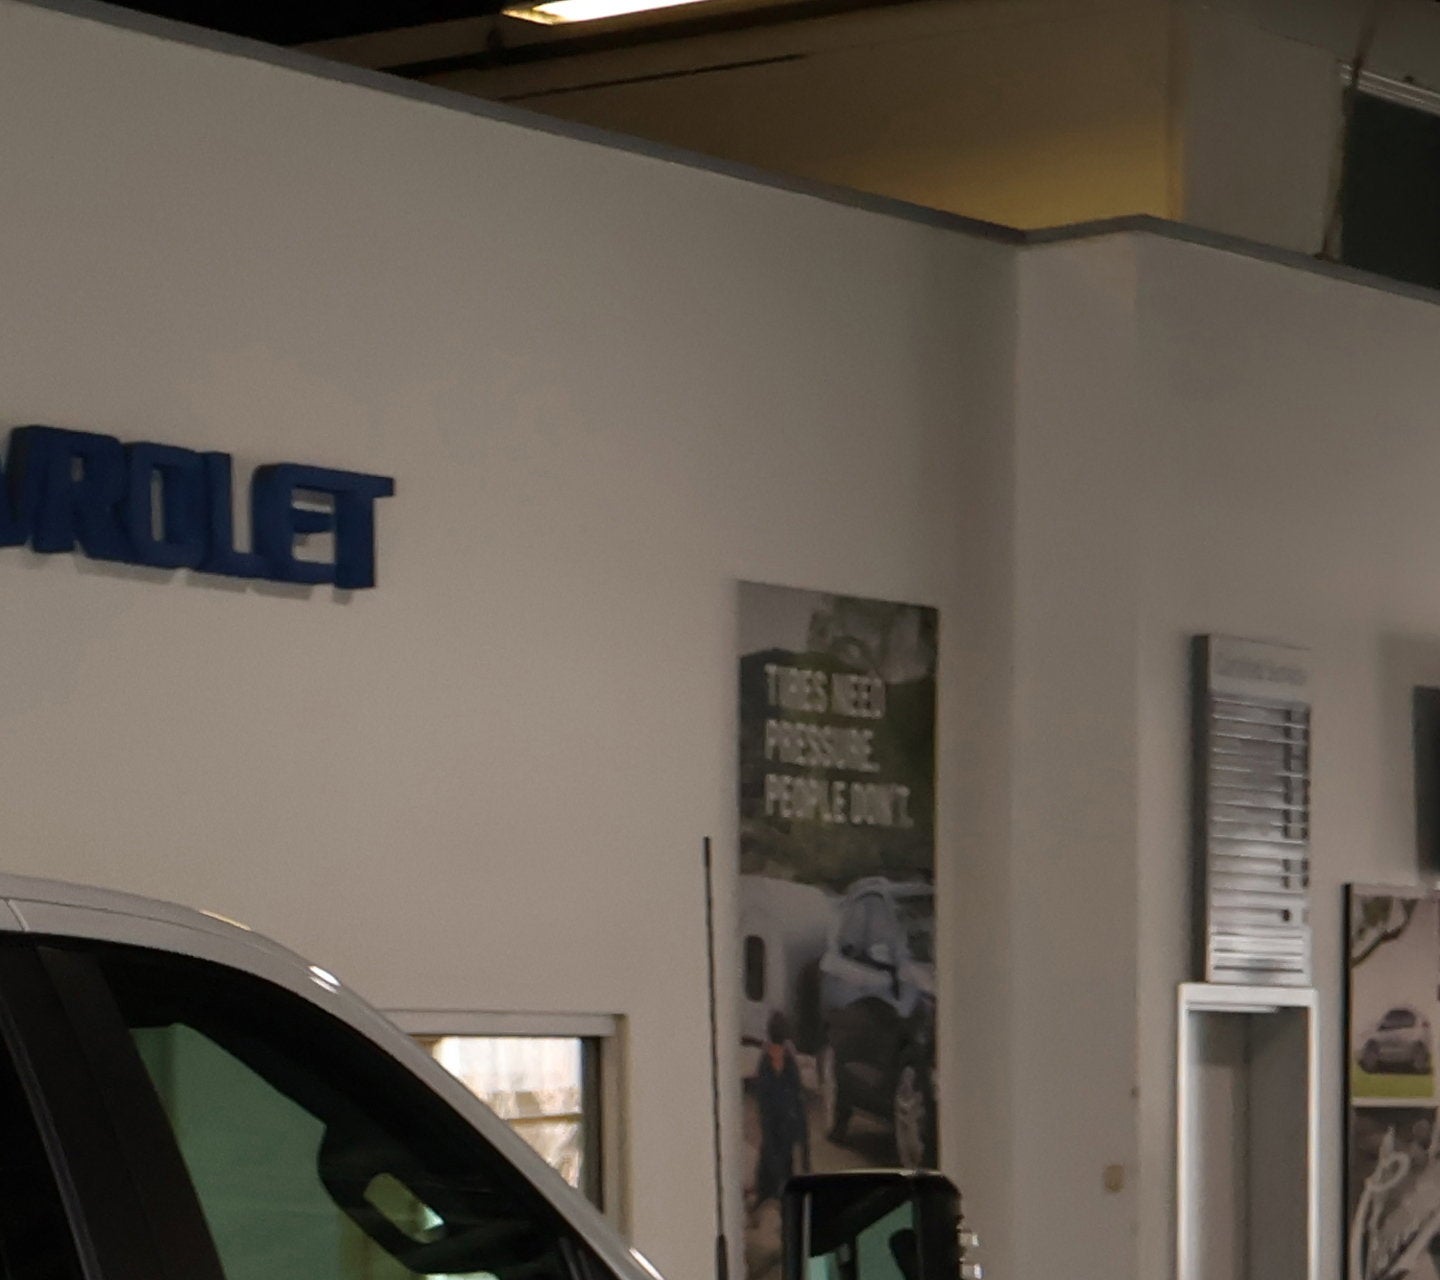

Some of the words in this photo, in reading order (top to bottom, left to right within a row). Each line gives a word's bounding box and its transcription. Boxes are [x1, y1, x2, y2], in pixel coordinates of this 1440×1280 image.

[764, 663, 828, 714] TIRES
[831, 672, 886, 719] NEED
[765, 772, 848, 825] PEOPLE
